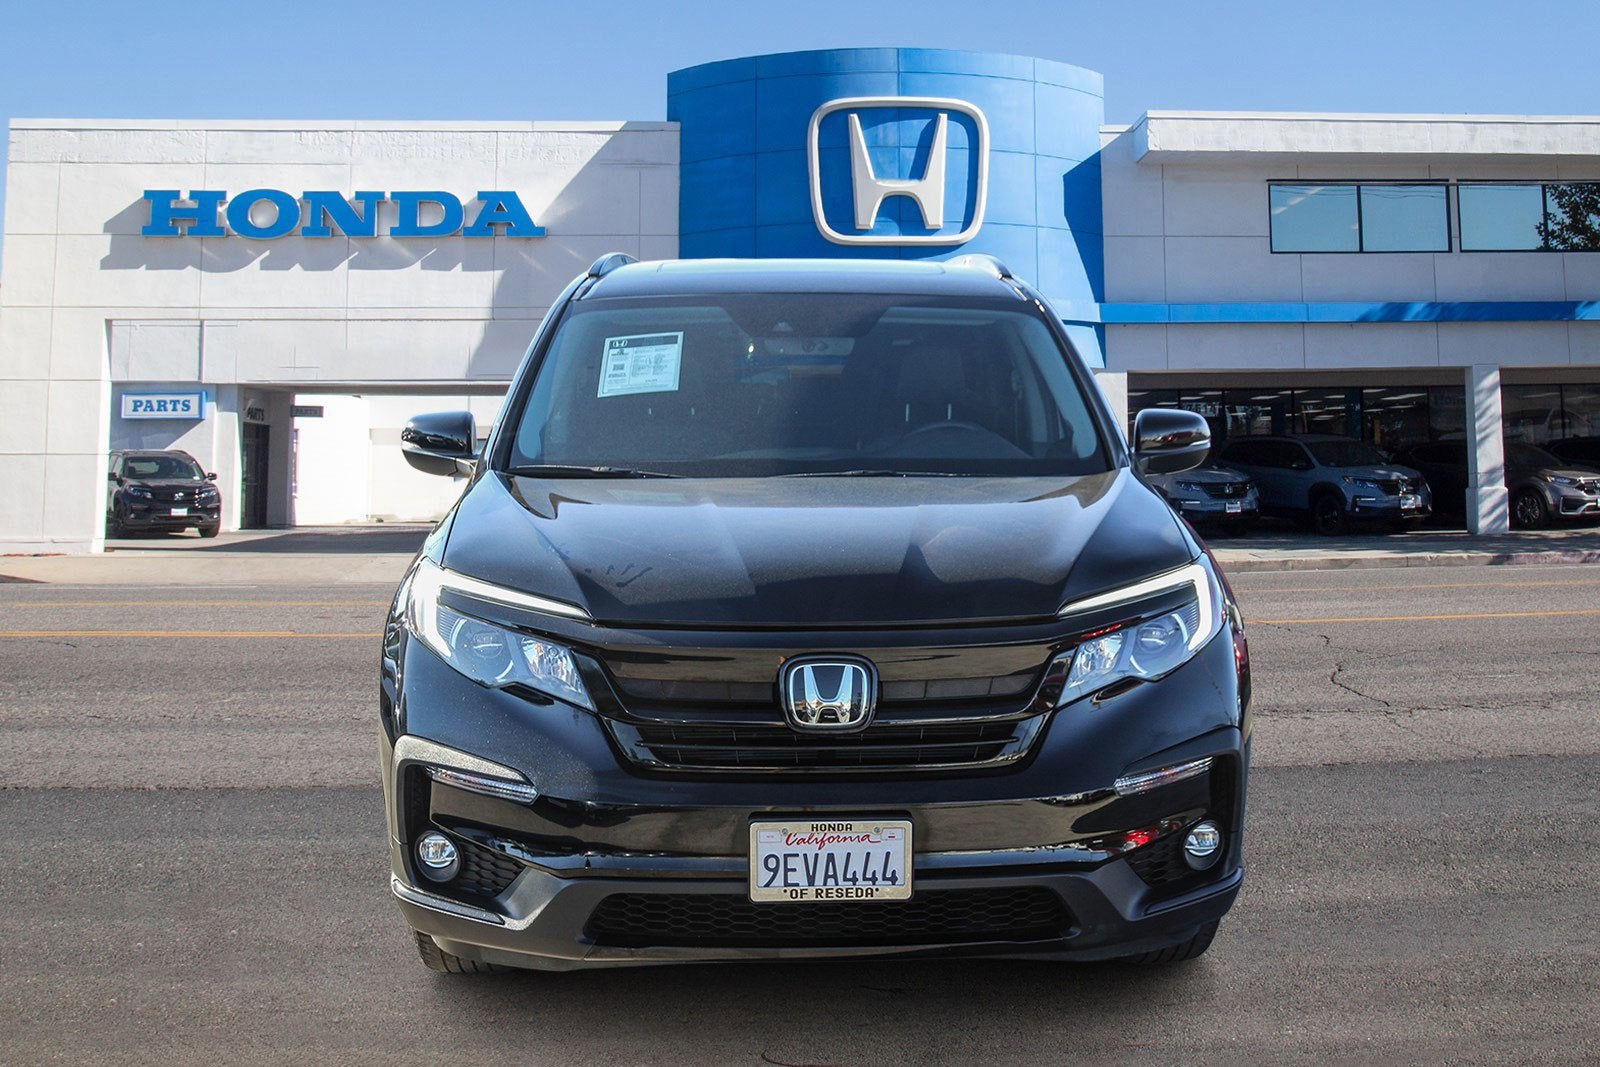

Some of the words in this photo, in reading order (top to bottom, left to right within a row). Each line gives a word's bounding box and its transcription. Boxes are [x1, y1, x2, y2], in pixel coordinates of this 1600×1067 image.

[141, 188, 548, 239] HONDA
[132, 399, 192, 413] PARTS
[811, 823, 853, 832] HONDA
[785, 832, 881, 850] California
[763, 851, 899, 888] 9EVA444
[789, 888, 808, 899] OF
[815, 887, 874, 899] RESEDA
